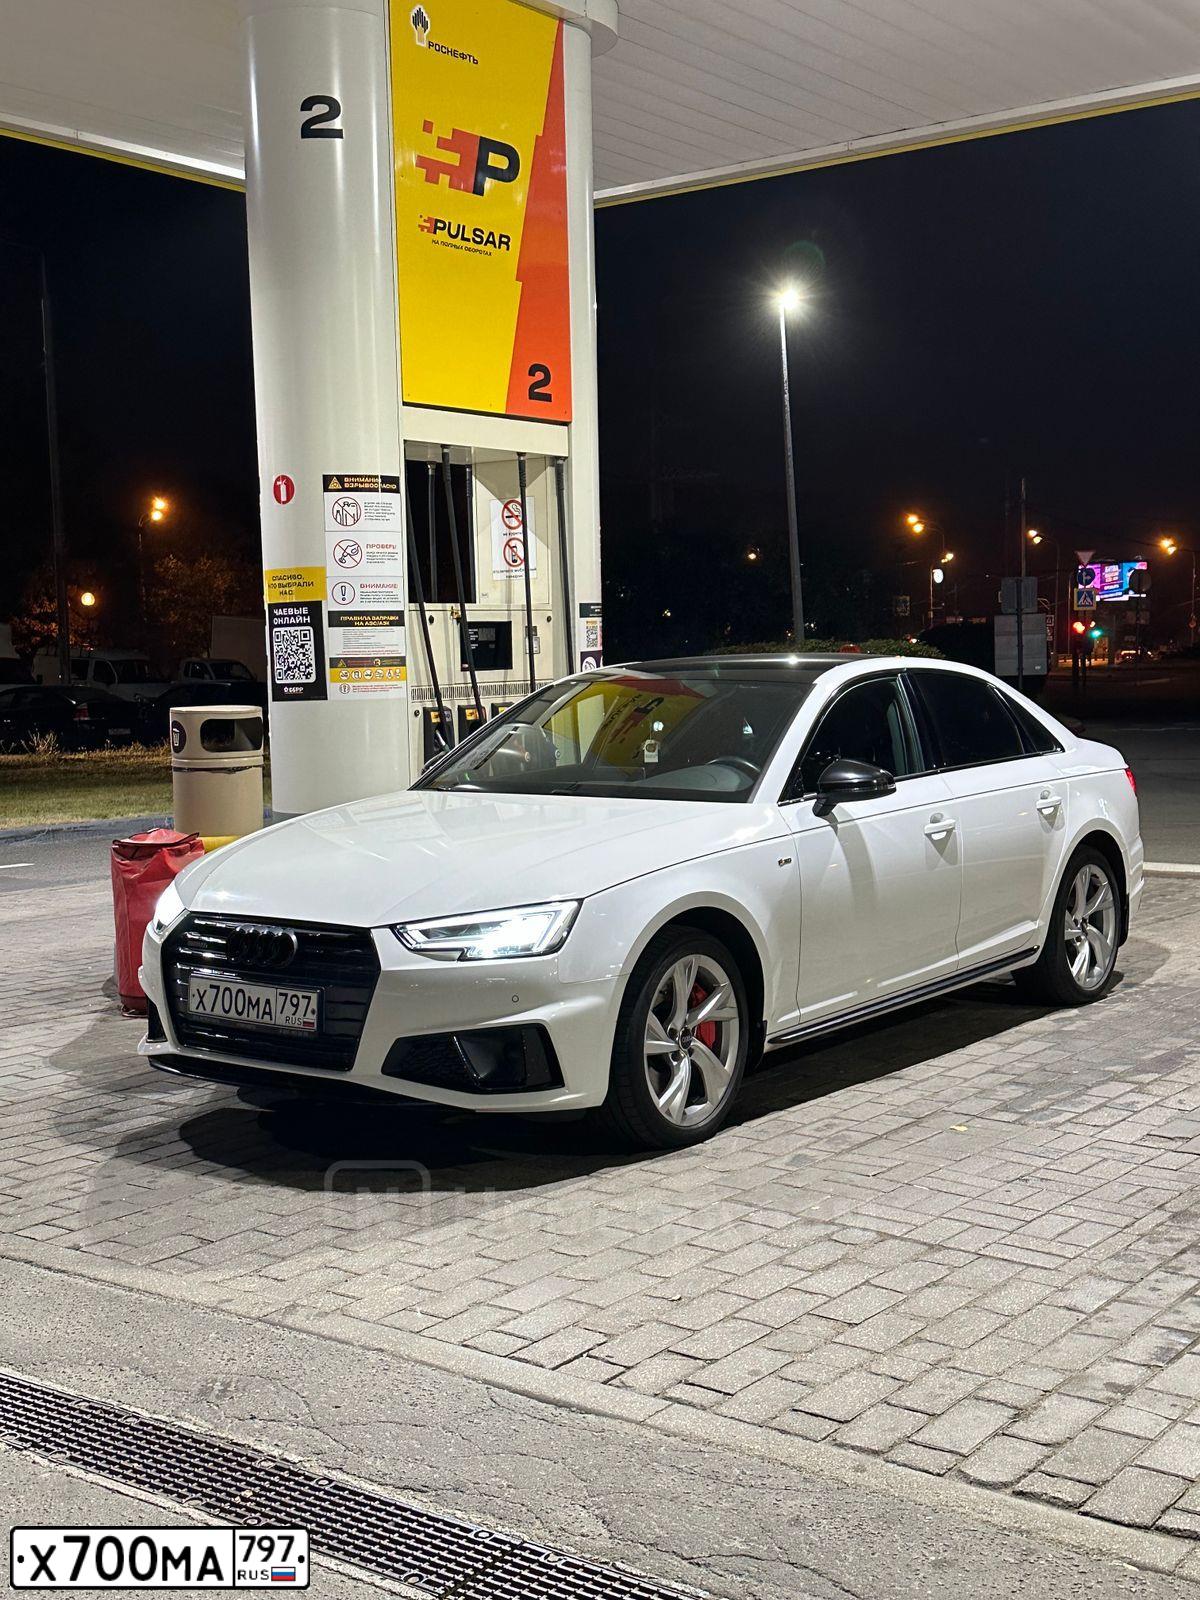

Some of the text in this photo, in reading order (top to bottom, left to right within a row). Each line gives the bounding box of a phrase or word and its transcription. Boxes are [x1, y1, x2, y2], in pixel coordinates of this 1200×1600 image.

[428, 41, 479, 65] РОСНЕФТЬ
[300, 95, 344, 139] 2
[433, 217, 511, 251] PULSAR
[440, 241, 464, 250] ПОЛНЫХ
[464, 246, 493, 257] ОБОРОТАХ
[528, 363, 553, 403] 2
[277, 581, 314, 589] ВЫБРАЛИ
[273, 607, 309, 616] ЧАЕВЫЕ
[273, 615, 311, 625] ОНЛАЙН
[279, 992, 312, 1018] 797
[285, 1015, 303, 1026] RUS
